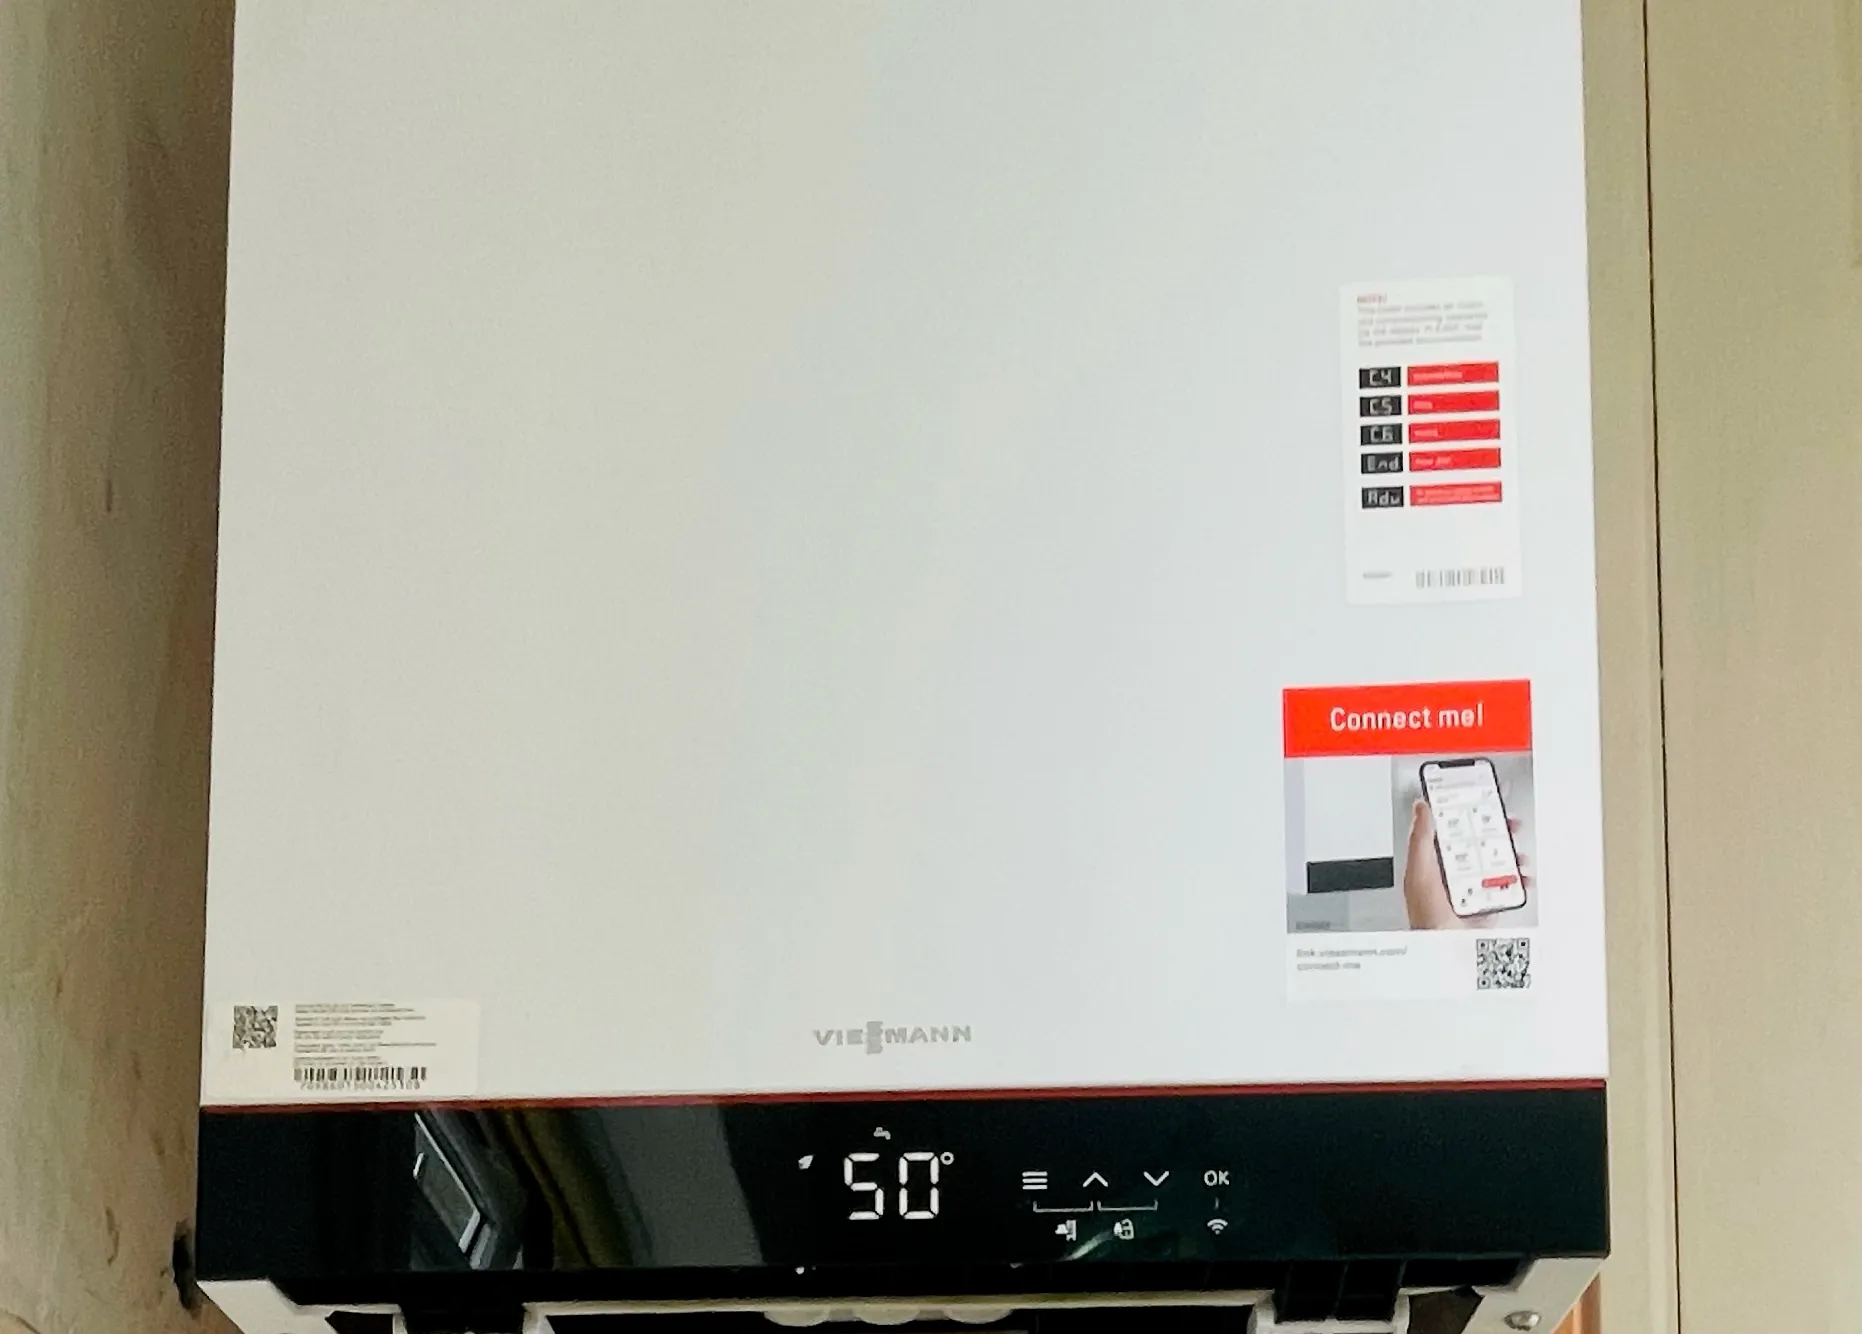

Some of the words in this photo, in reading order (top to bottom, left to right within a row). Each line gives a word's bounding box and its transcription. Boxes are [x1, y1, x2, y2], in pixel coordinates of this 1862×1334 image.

[1368, 368, 1392, 386] C4
[1330, 707, 1431, 731] Connect
[1438, 703, 1484, 728] me!
[1203, 1170, 1231, 1187] OK
